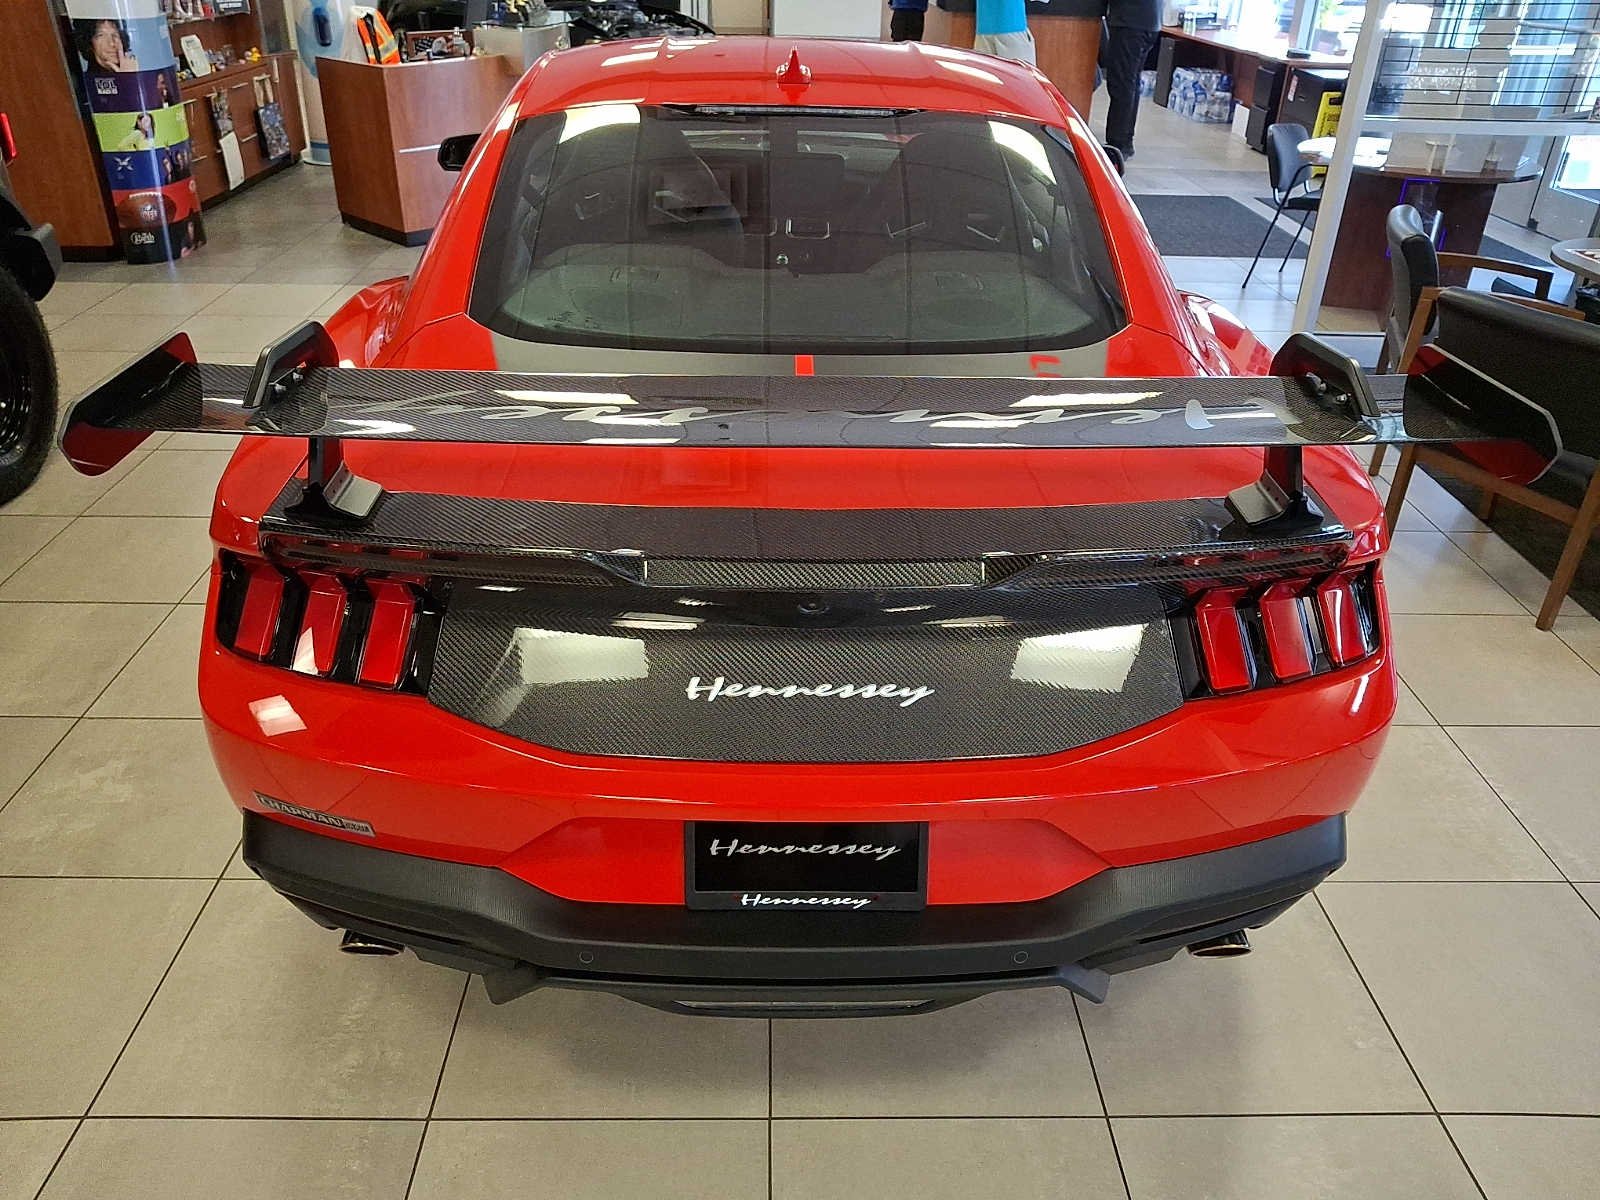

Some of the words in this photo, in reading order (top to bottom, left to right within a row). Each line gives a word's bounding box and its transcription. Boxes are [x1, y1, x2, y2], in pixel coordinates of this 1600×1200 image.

[685, 676, 935, 707] Hennessey
[710, 839, 901, 861] Hennessey
[741, 893, 871, 910] Hennessey
